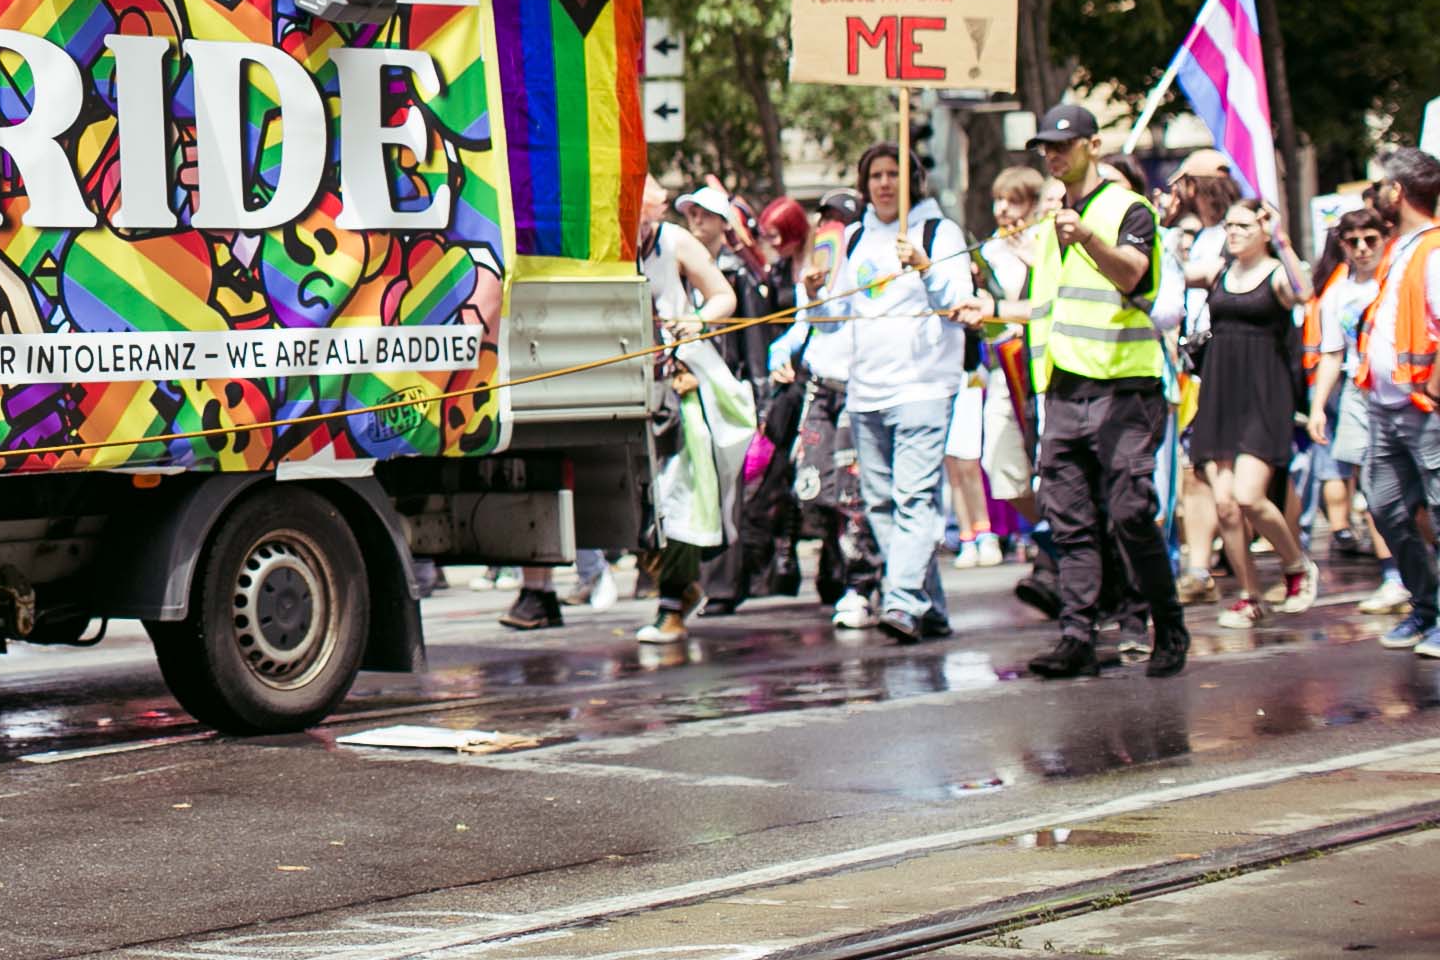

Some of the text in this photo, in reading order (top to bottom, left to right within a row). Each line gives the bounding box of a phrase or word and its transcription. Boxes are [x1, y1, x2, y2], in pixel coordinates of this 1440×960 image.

[846, 15, 946, 81] ME
[26, 342, 196, 376] INTOLERANZ
[226, 341, 266, 369] WE
[275, 340, 319, 368] ARE
[326, 337, 369, 366] ALL
[375, 335, 479, 364] BADDIES
